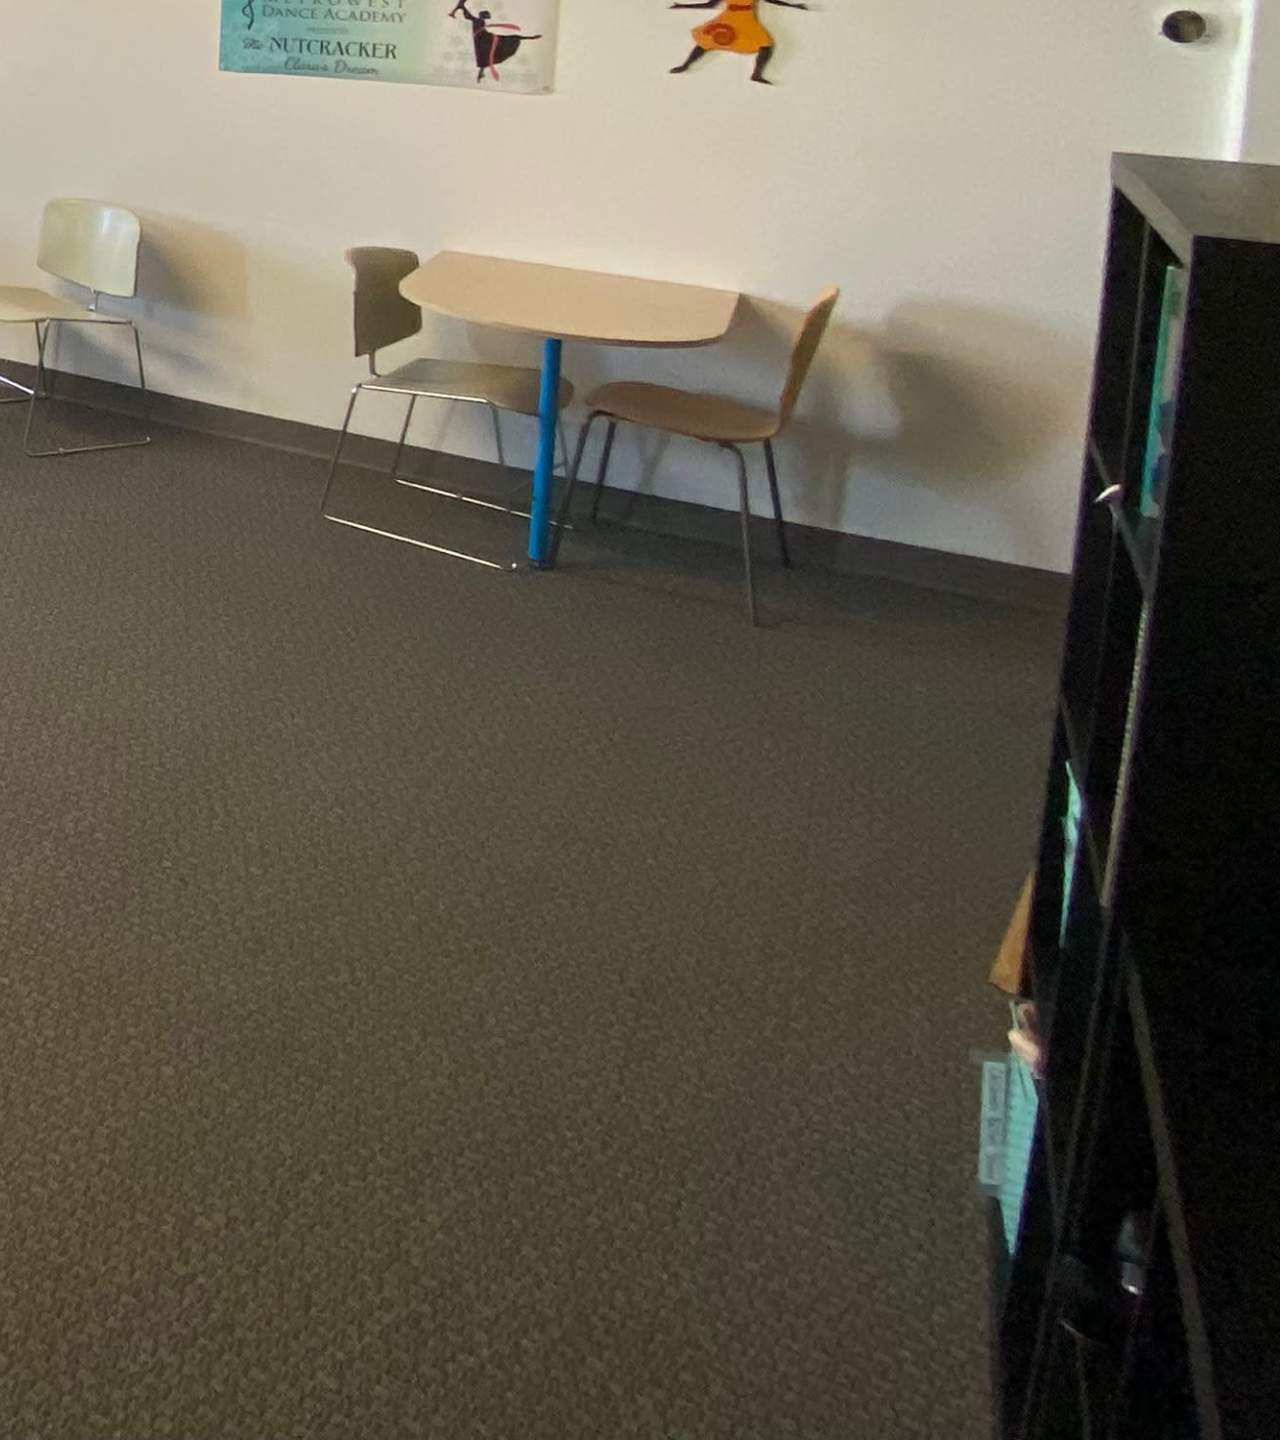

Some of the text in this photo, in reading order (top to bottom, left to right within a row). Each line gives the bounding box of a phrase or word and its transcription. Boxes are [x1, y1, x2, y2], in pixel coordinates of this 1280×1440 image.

[261, 3, 407, 24] DANCE ACADEMY
[269, 36, 397, 60] NUTCRACKER
